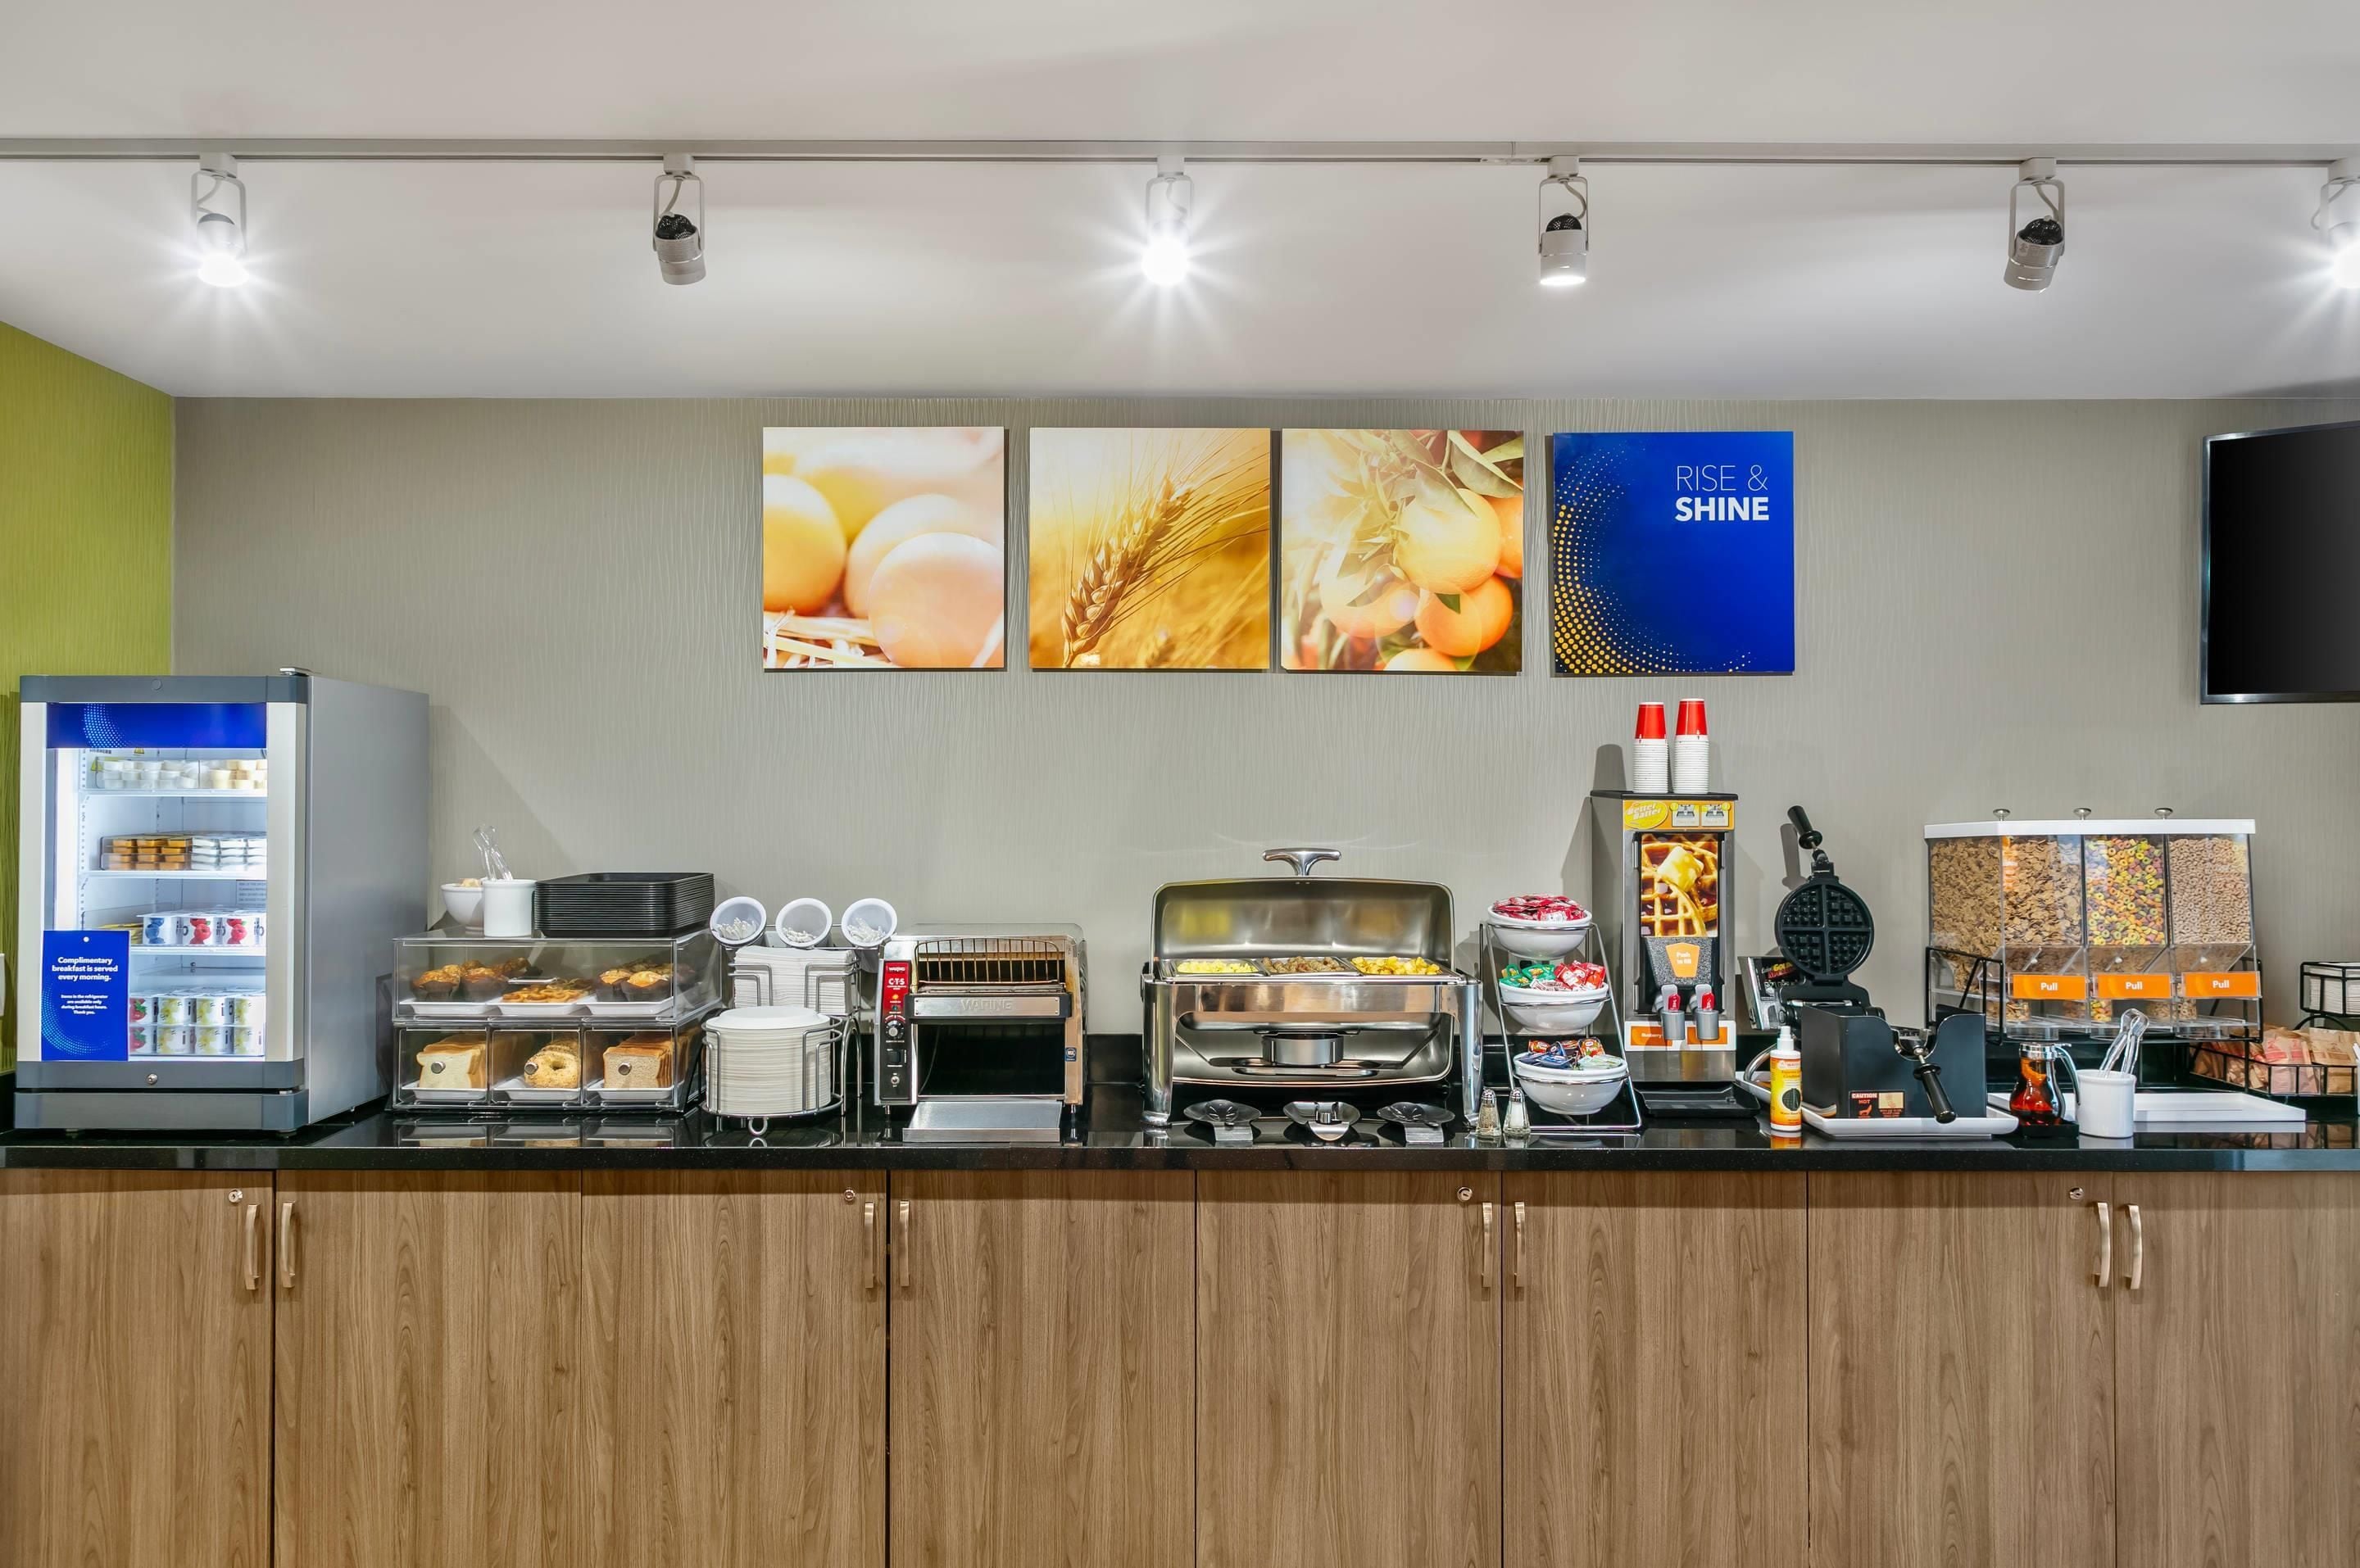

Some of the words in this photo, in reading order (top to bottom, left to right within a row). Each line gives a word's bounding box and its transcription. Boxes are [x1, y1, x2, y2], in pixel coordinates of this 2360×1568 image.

[1676, 465, 1737, 492] RISE
[1747, 465, 1768, 492] &
[1674, 496, 1770, 522] SHINE
[57, 957, 113, 965] Complimentary
[79, 973, 111, 981] morning.
[2040, 982, 2058, 990] Pull
[2125, 981, 2143, 990] Pull
[2212, 979, 2230, 988] Pull
[960, 998, 1014, 1011] WARING
